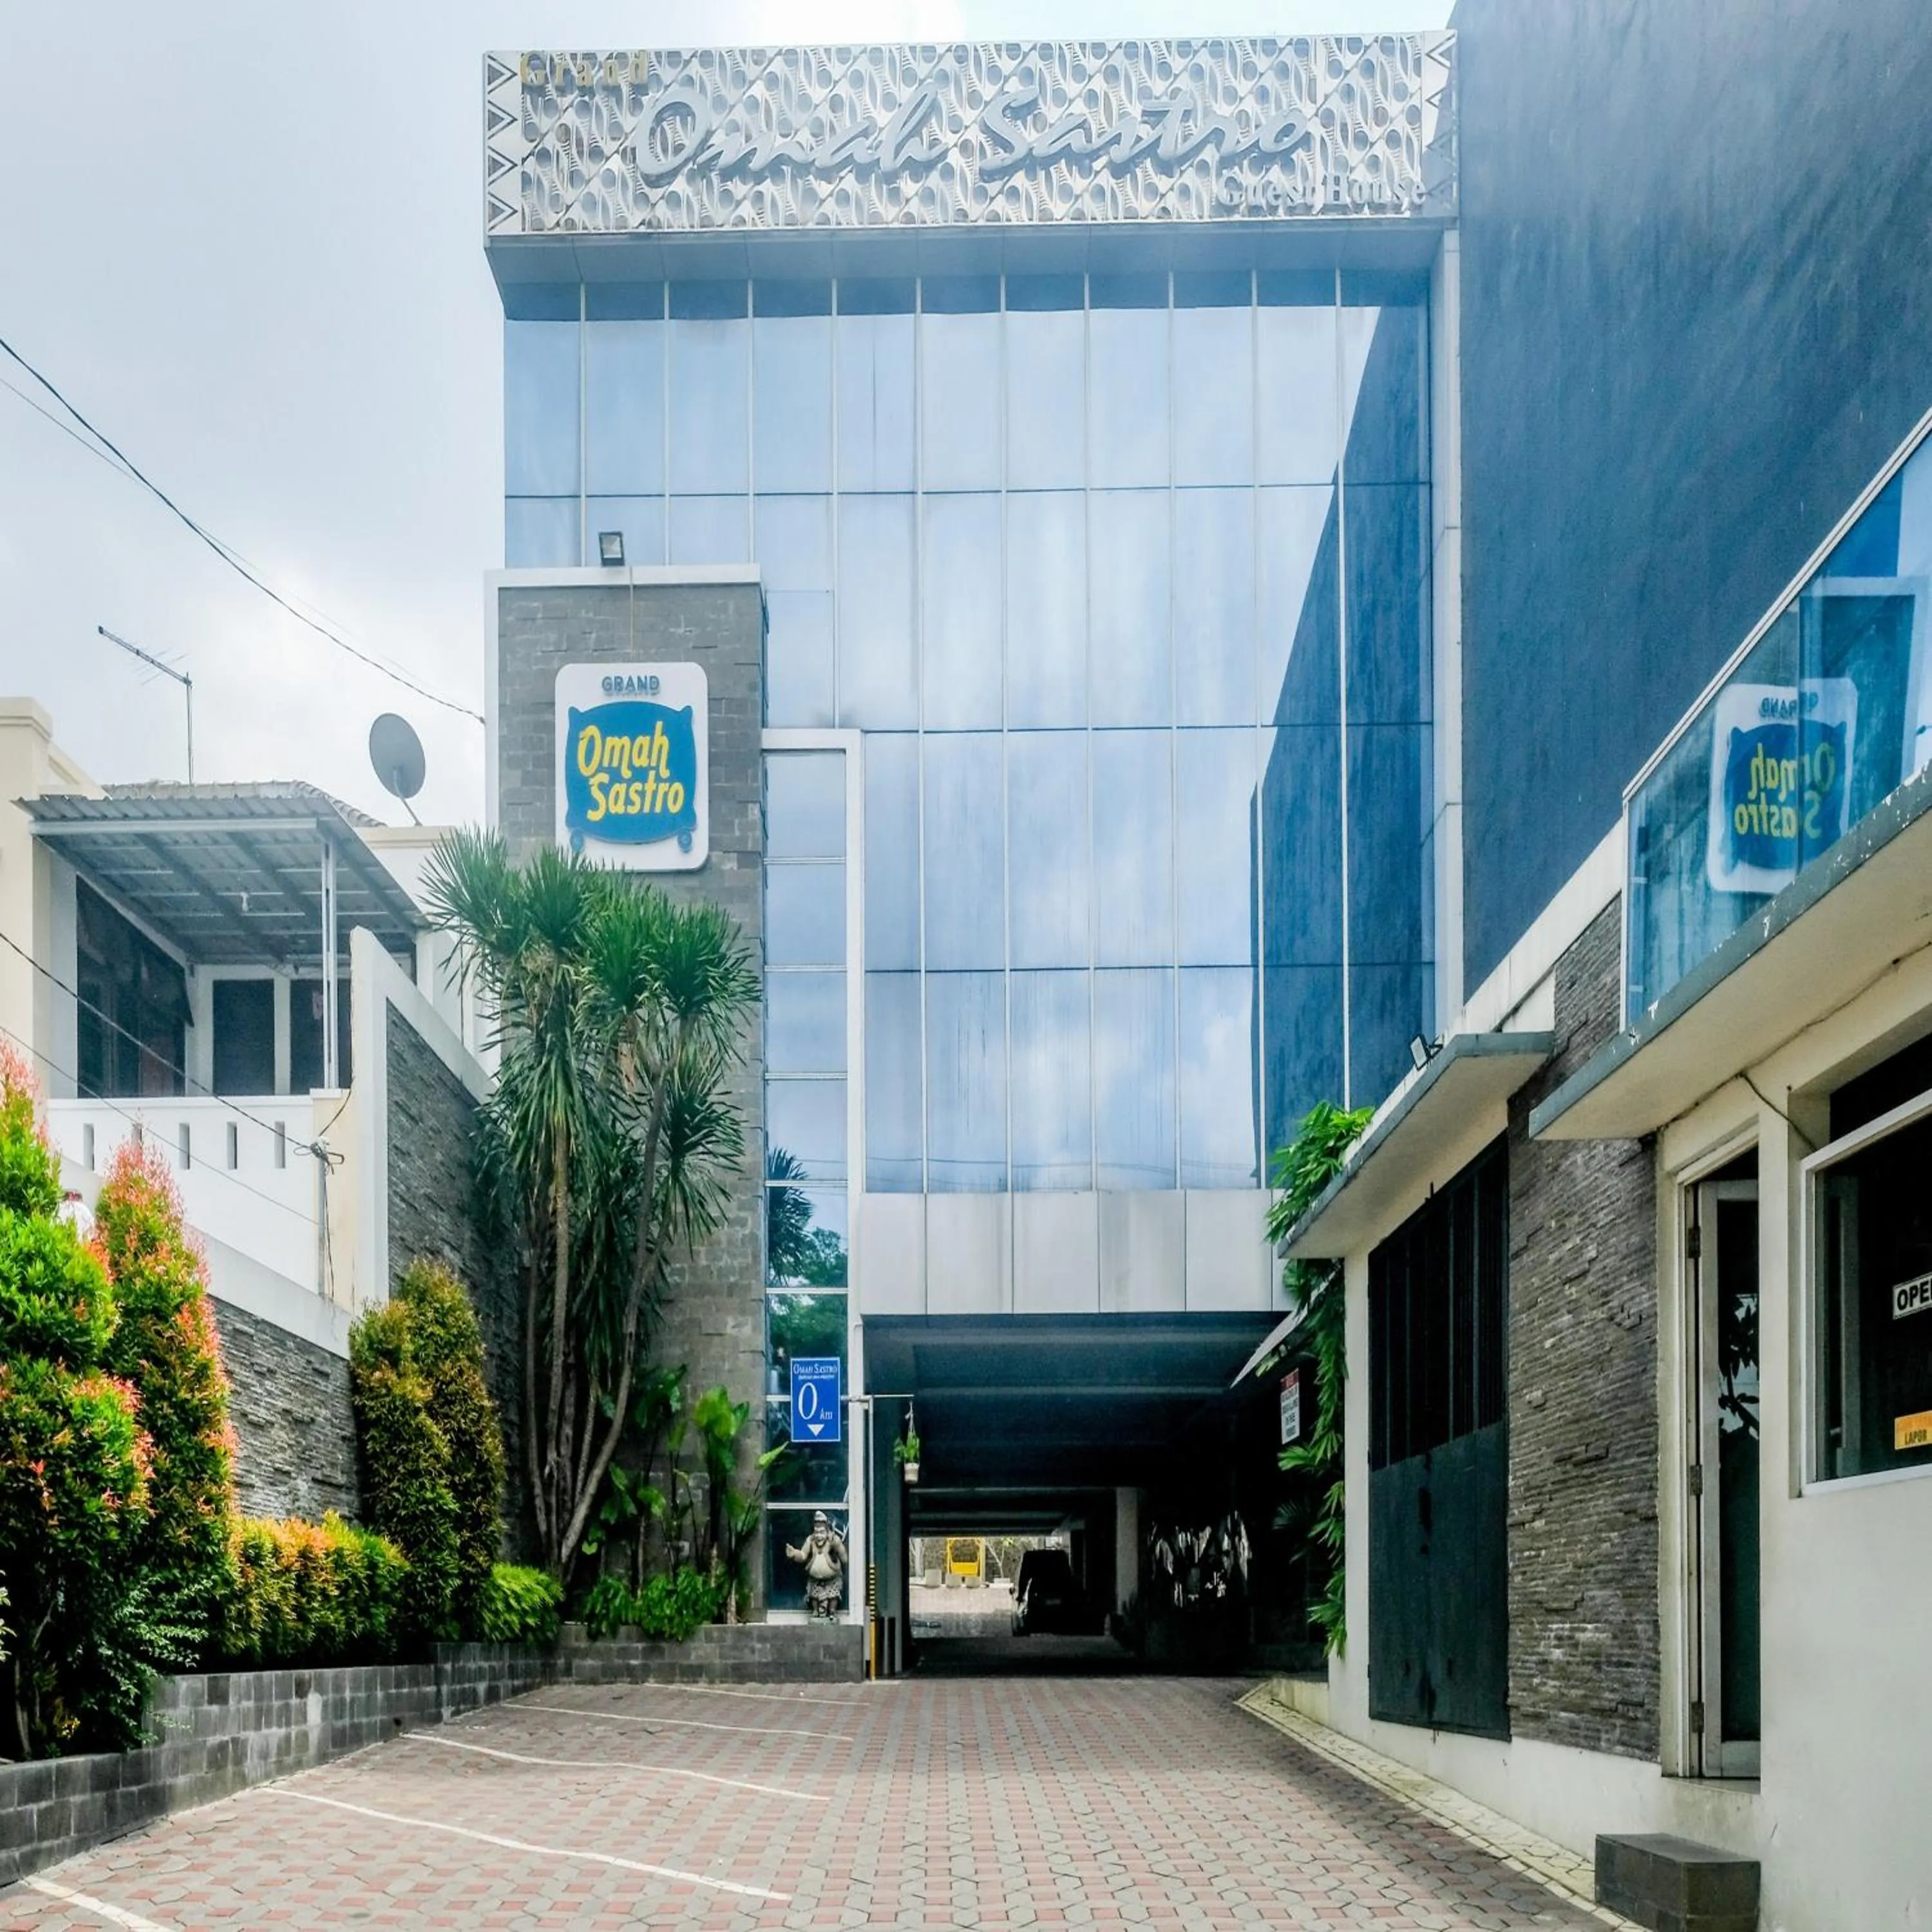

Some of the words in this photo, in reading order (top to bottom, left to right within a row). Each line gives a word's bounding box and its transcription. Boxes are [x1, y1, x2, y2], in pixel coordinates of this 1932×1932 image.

[520, 50, 648, 86] Grand
[636, 80, 949, 177] Omah
[978, 86, 1309, 171] Sastro
[1217, 174, 1320, 206] Guest
[1322, 173, 1426, 205] House
[601, 675, 661, 694] GRAND
[577, 721, 670, 779] Omah
[587, 770, 685, 822] Sastro
[1897, 1278, 1932, 1311] OPE
[798, 1382, 817, 1420] 0
